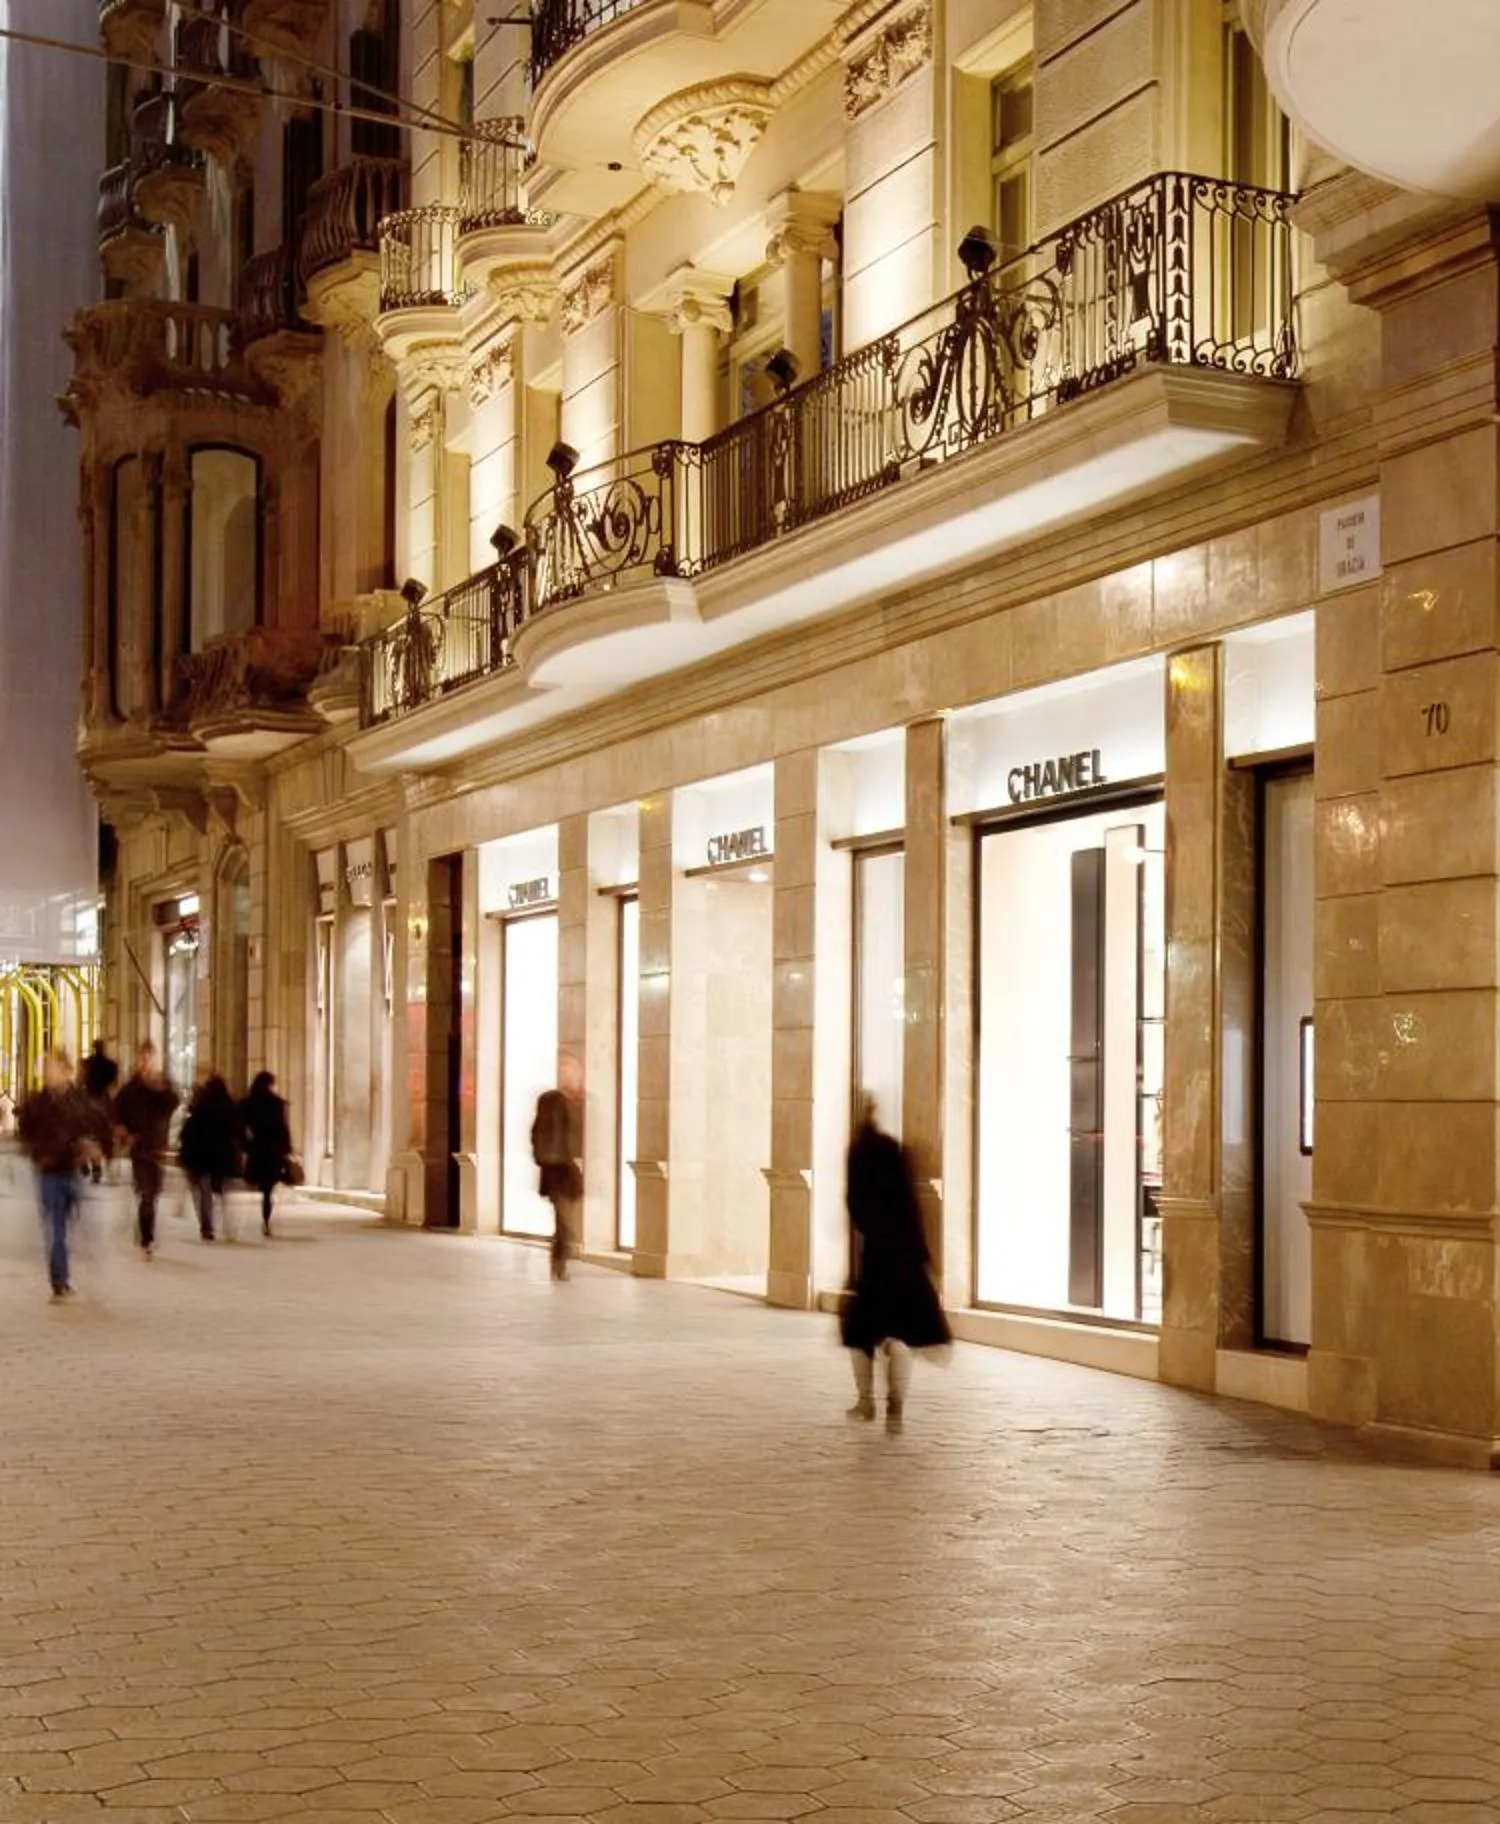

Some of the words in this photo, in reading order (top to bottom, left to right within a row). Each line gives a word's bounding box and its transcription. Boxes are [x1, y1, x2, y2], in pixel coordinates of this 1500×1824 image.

[1421, 702, 1450, 737] 70
[1008, 749, 1106, 802] CHANEL
[708, 826, 767, 863] CHANEL
